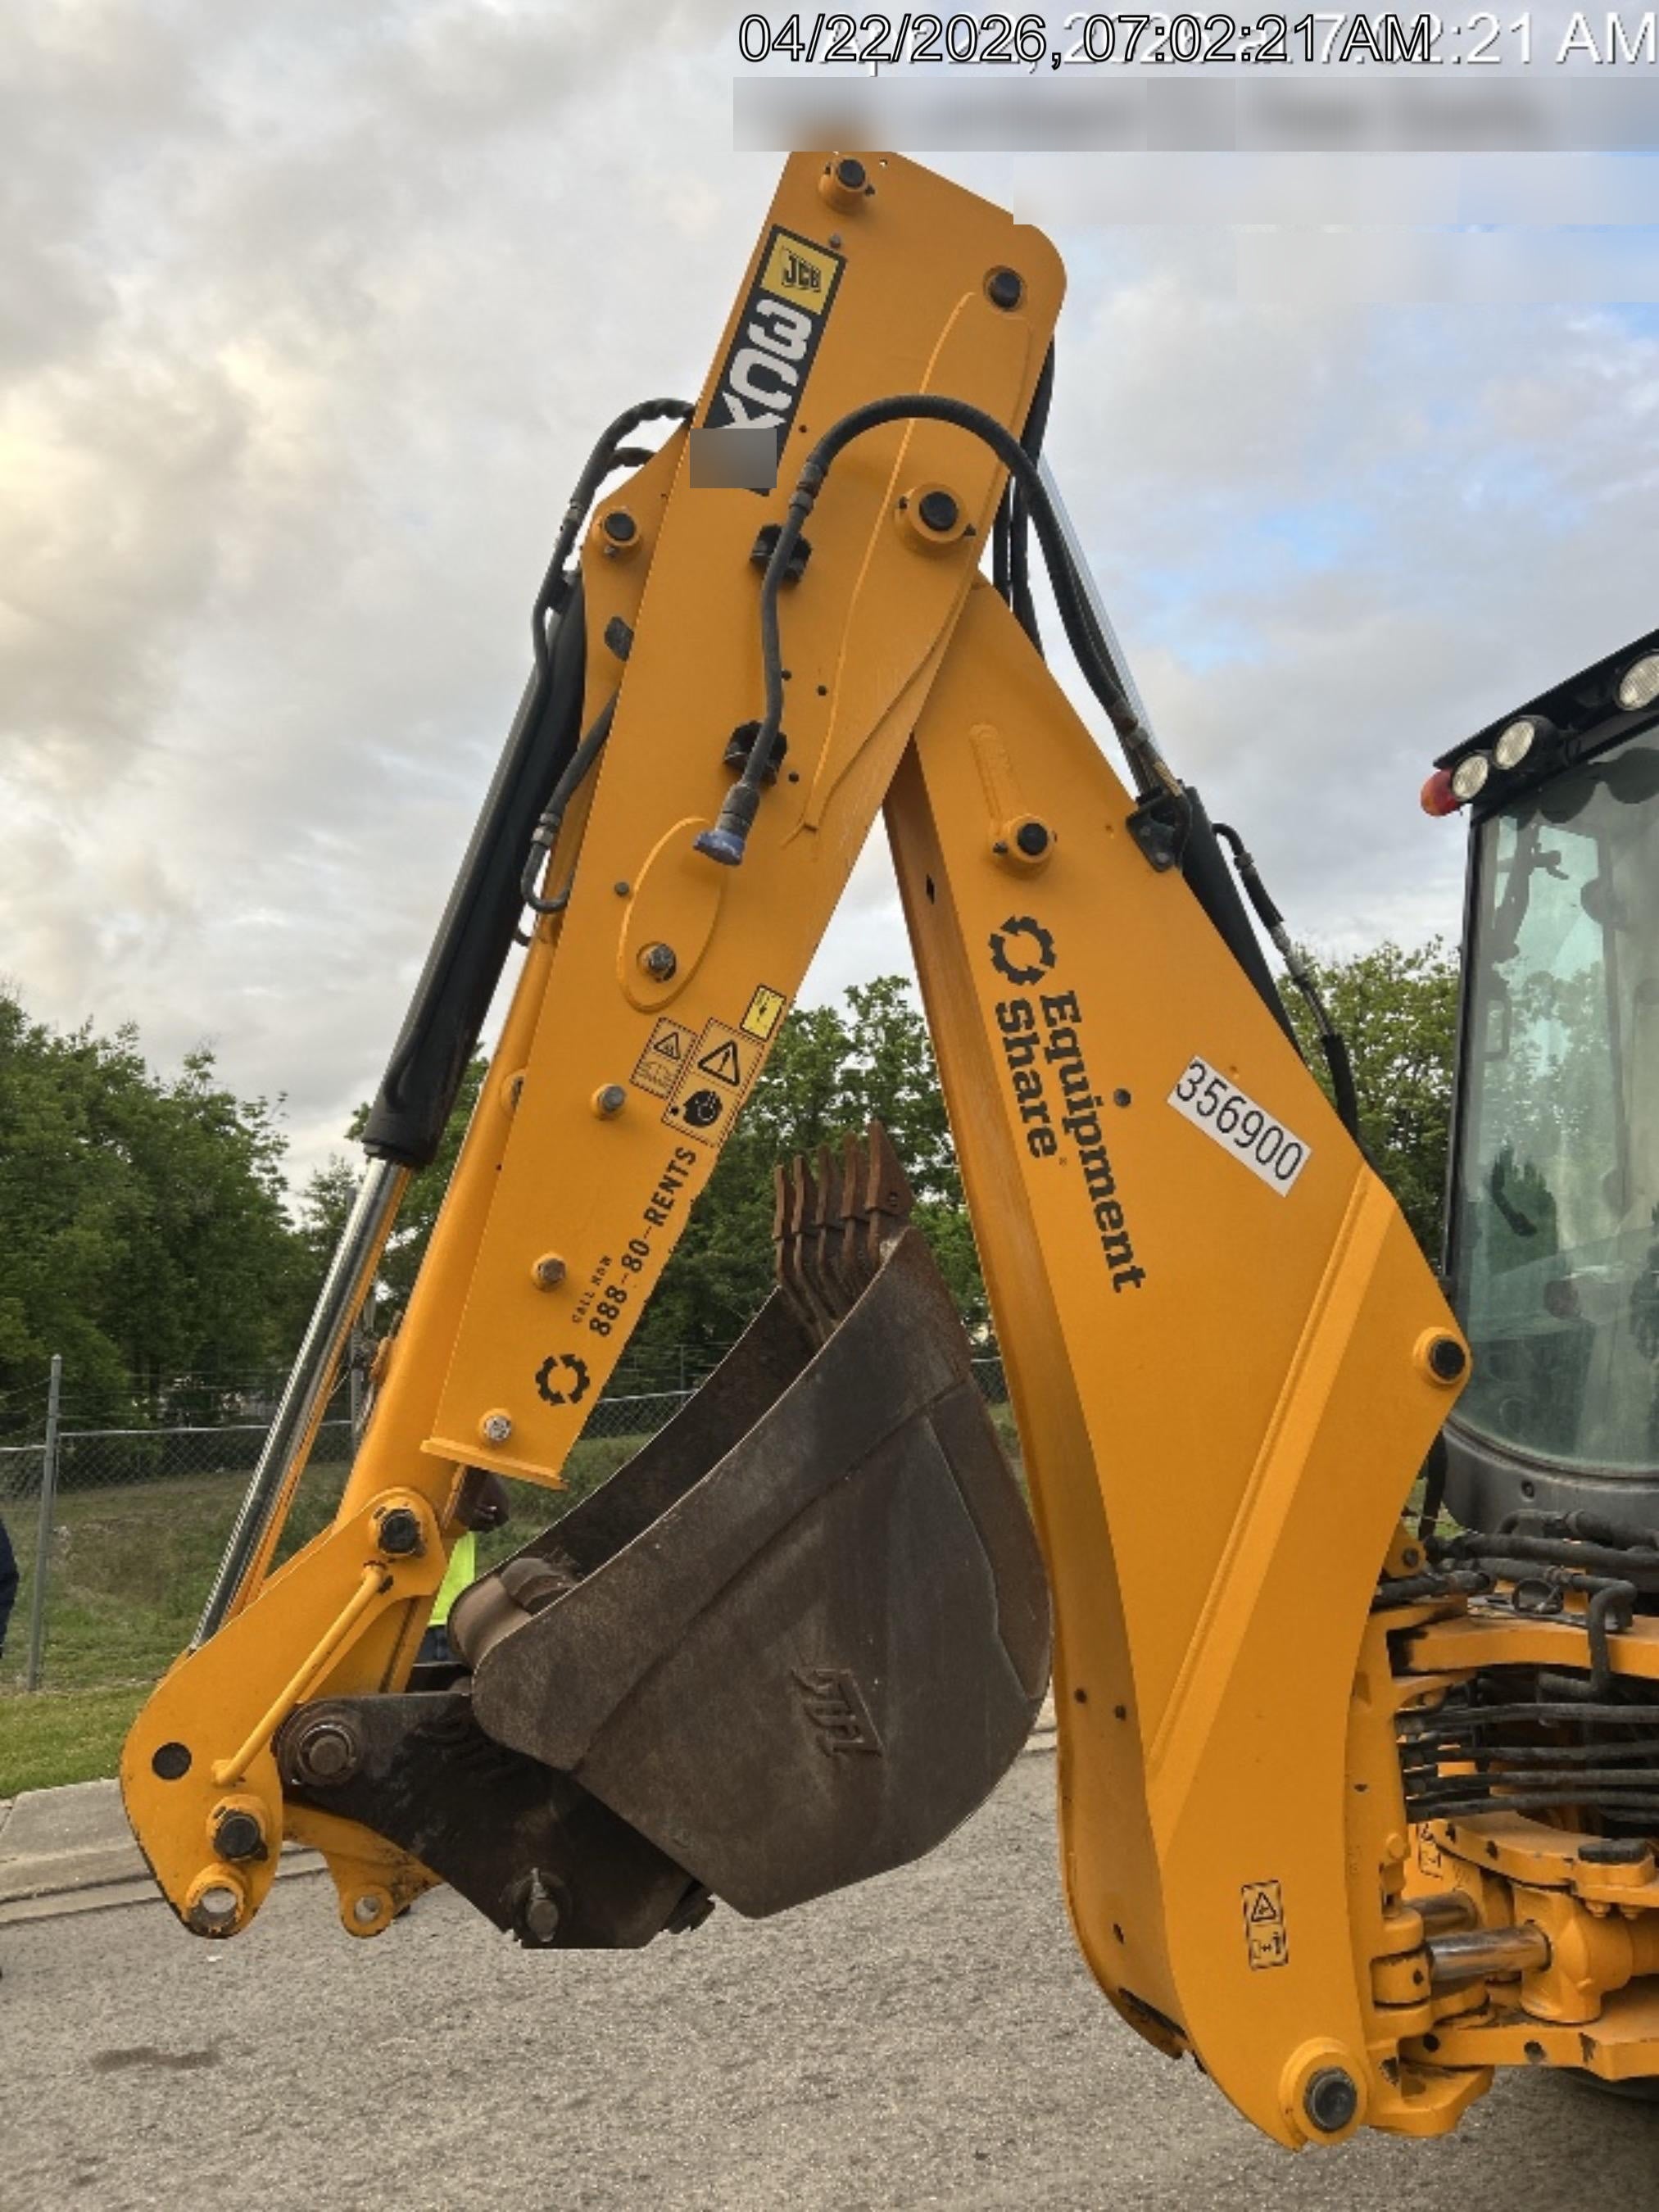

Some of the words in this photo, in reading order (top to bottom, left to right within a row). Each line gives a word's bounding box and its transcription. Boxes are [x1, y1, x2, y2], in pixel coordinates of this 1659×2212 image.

[783, 254, 821, 289] JCB
[995, 998, 1058, 1158] Share
[1040, 990, 1146, 1293] Equipment
[1176, 1063, 1304, 1181] 356900
[590, 1147, 696, 1336] 888-80-RENTS
